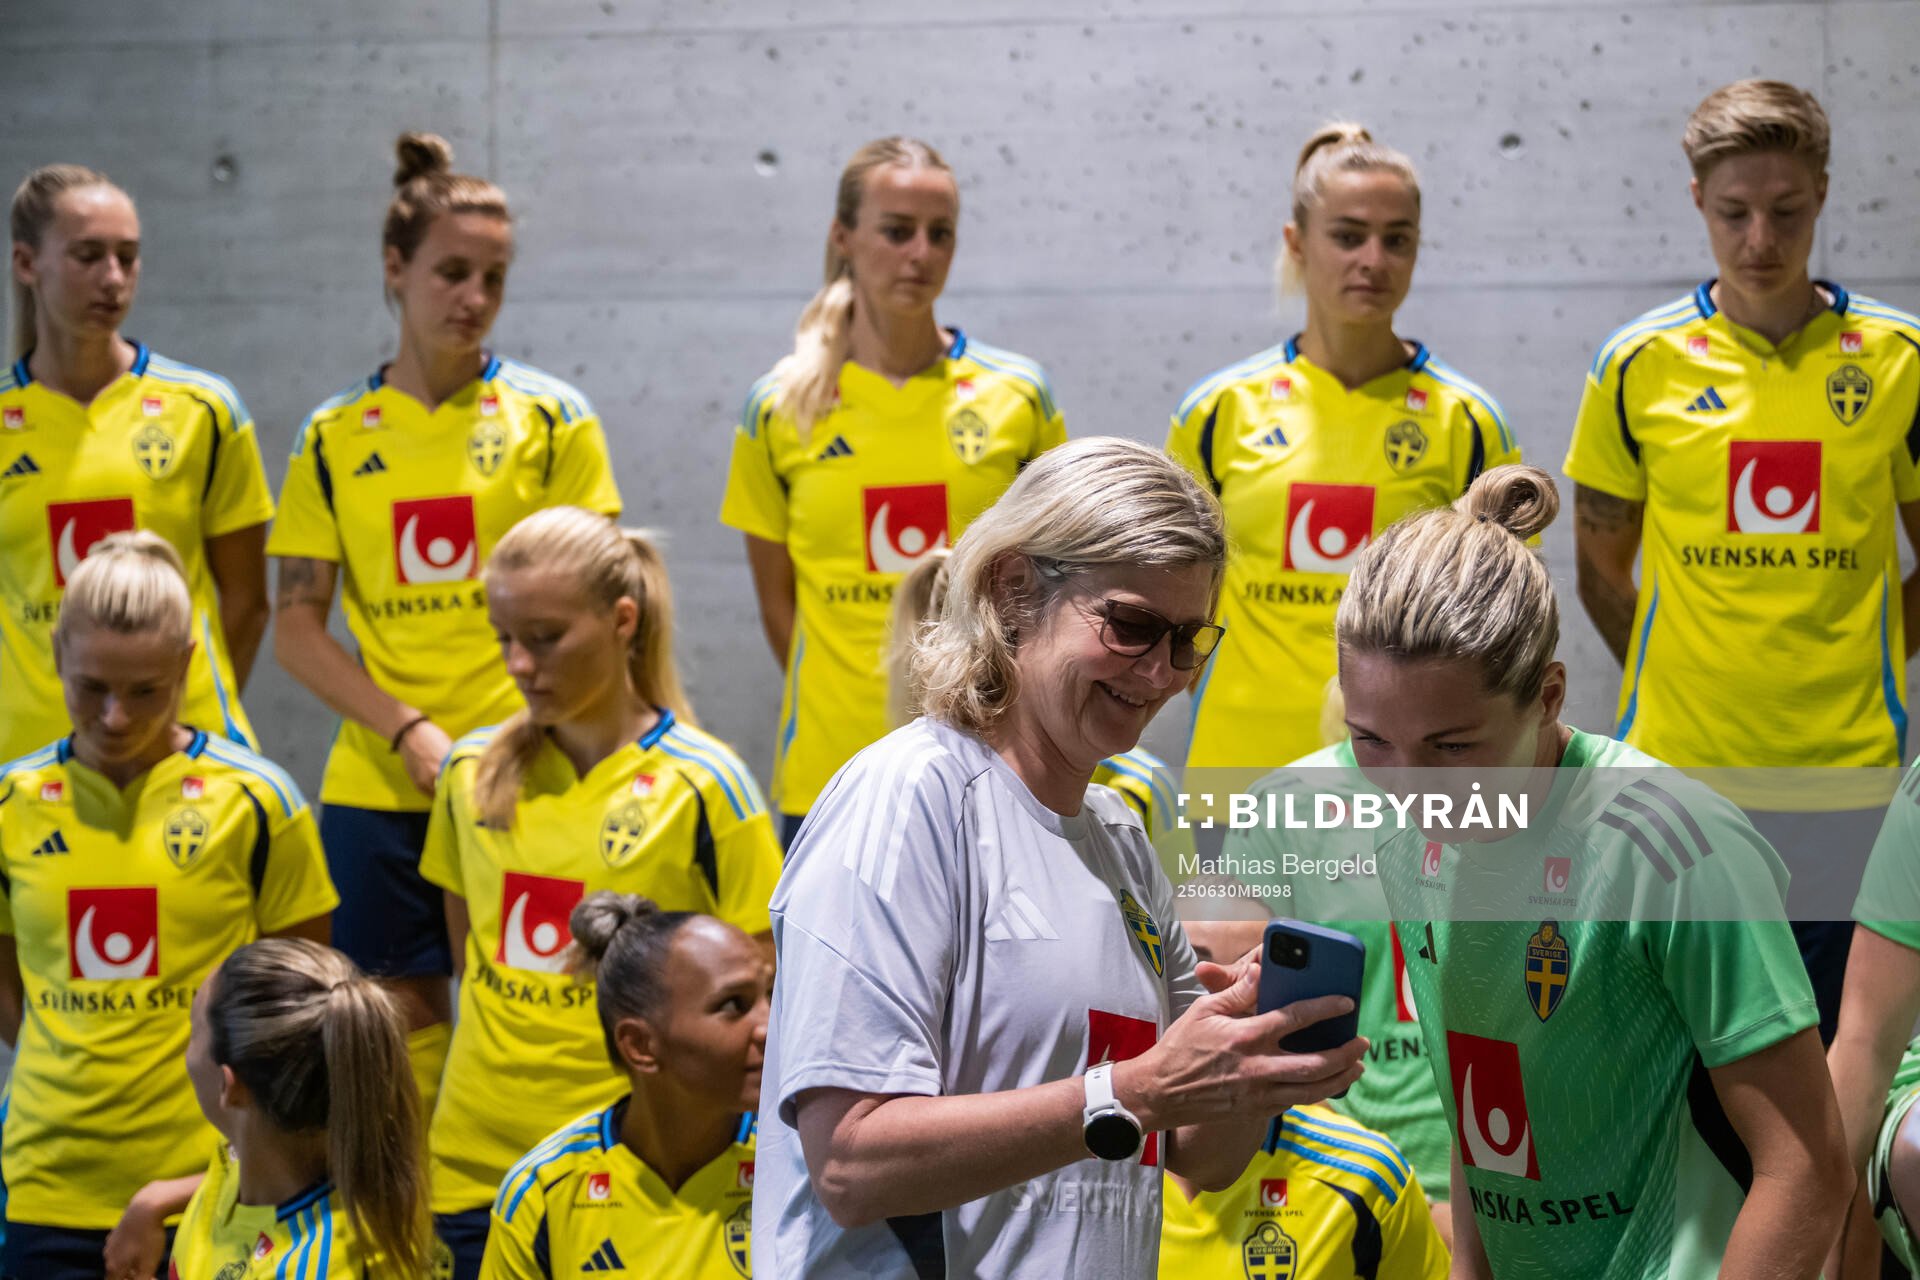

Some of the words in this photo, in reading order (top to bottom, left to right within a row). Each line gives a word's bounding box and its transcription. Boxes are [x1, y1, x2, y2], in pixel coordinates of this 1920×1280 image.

[1682, 545, 1797, 568] SVENSKA
[1806, 547, 1860, 570] SPEL
[825, 583, 893, 604] SVENS
[561, 985, 592, 1009] SP
[1468, 1192, 1535, 1227] NSKA
[1540, 1191, 1634, 1226] SPEL
